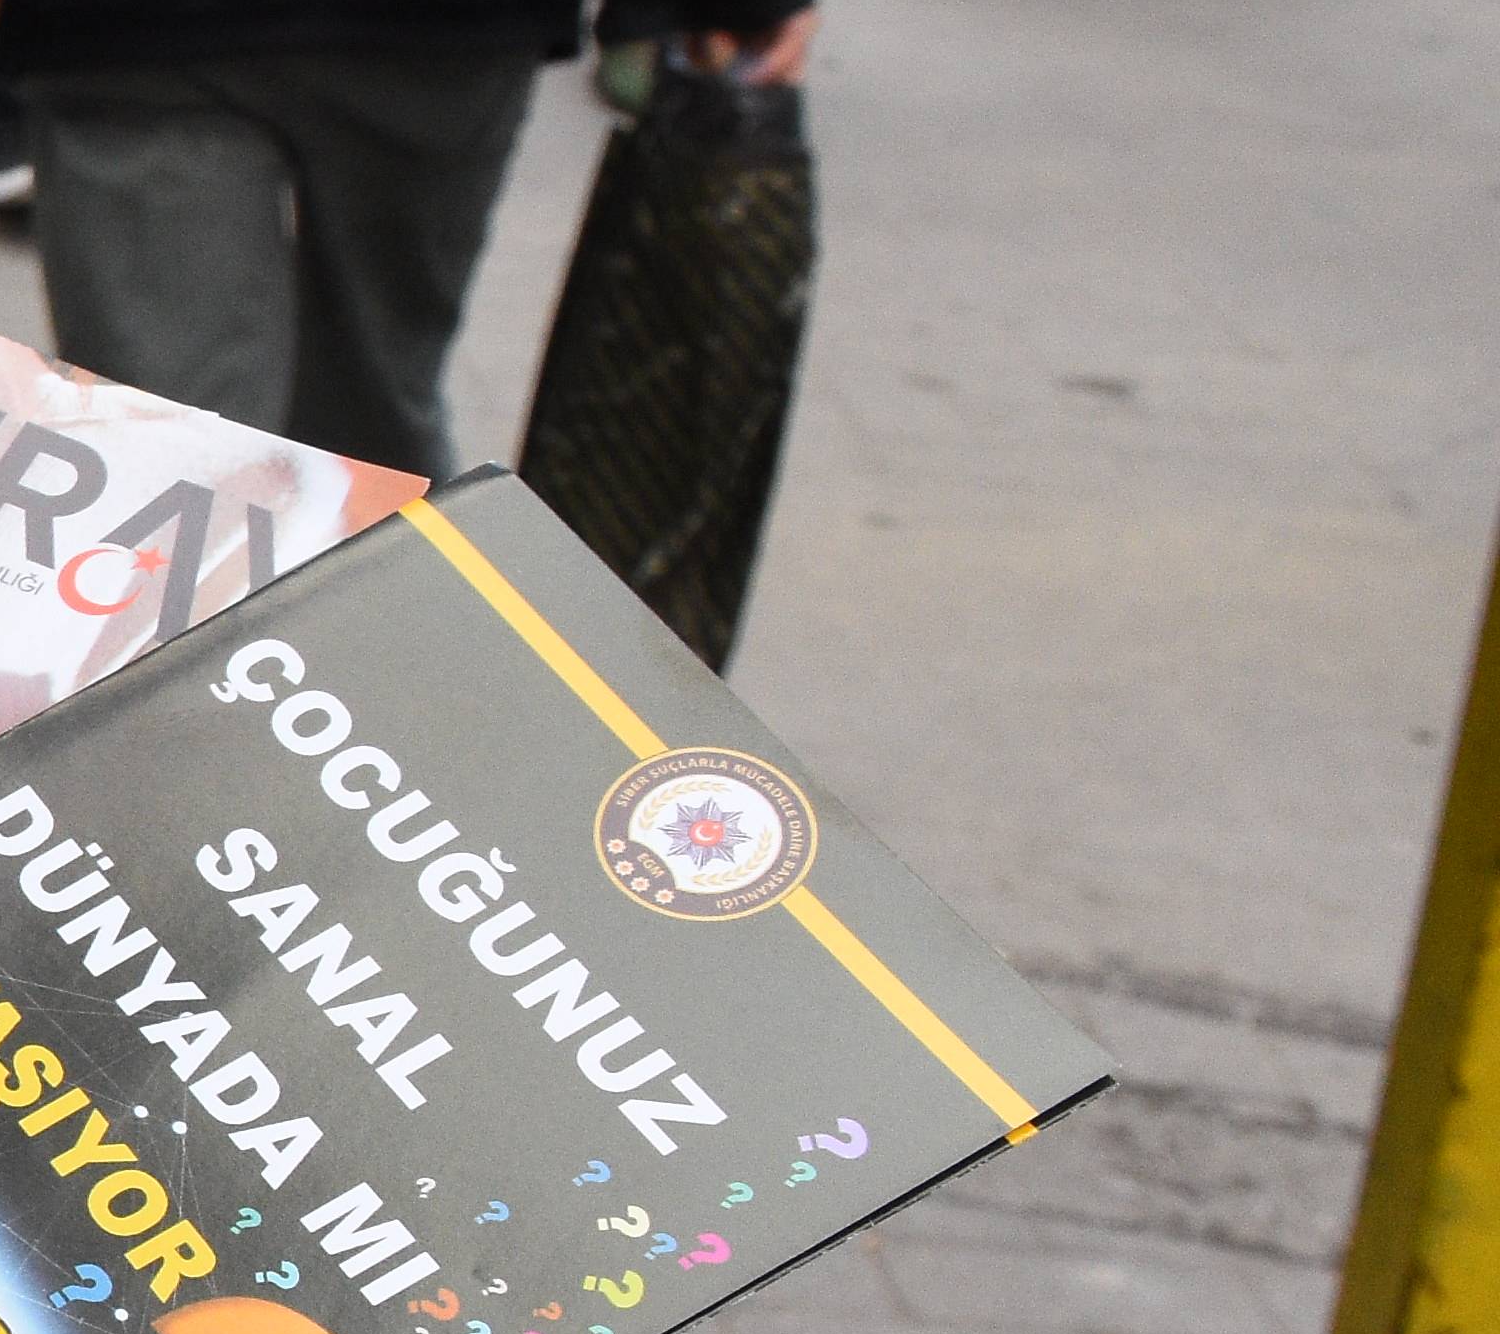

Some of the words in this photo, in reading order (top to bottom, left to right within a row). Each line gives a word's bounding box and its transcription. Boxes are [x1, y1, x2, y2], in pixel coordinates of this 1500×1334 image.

[207, 638, 729, 1157] ÇOCUĞUNUZ
[635, 851, 666, 879] EGM
[196, 827, 454, 1111] SANAL
[299, 1181, 441, 1307] MI
